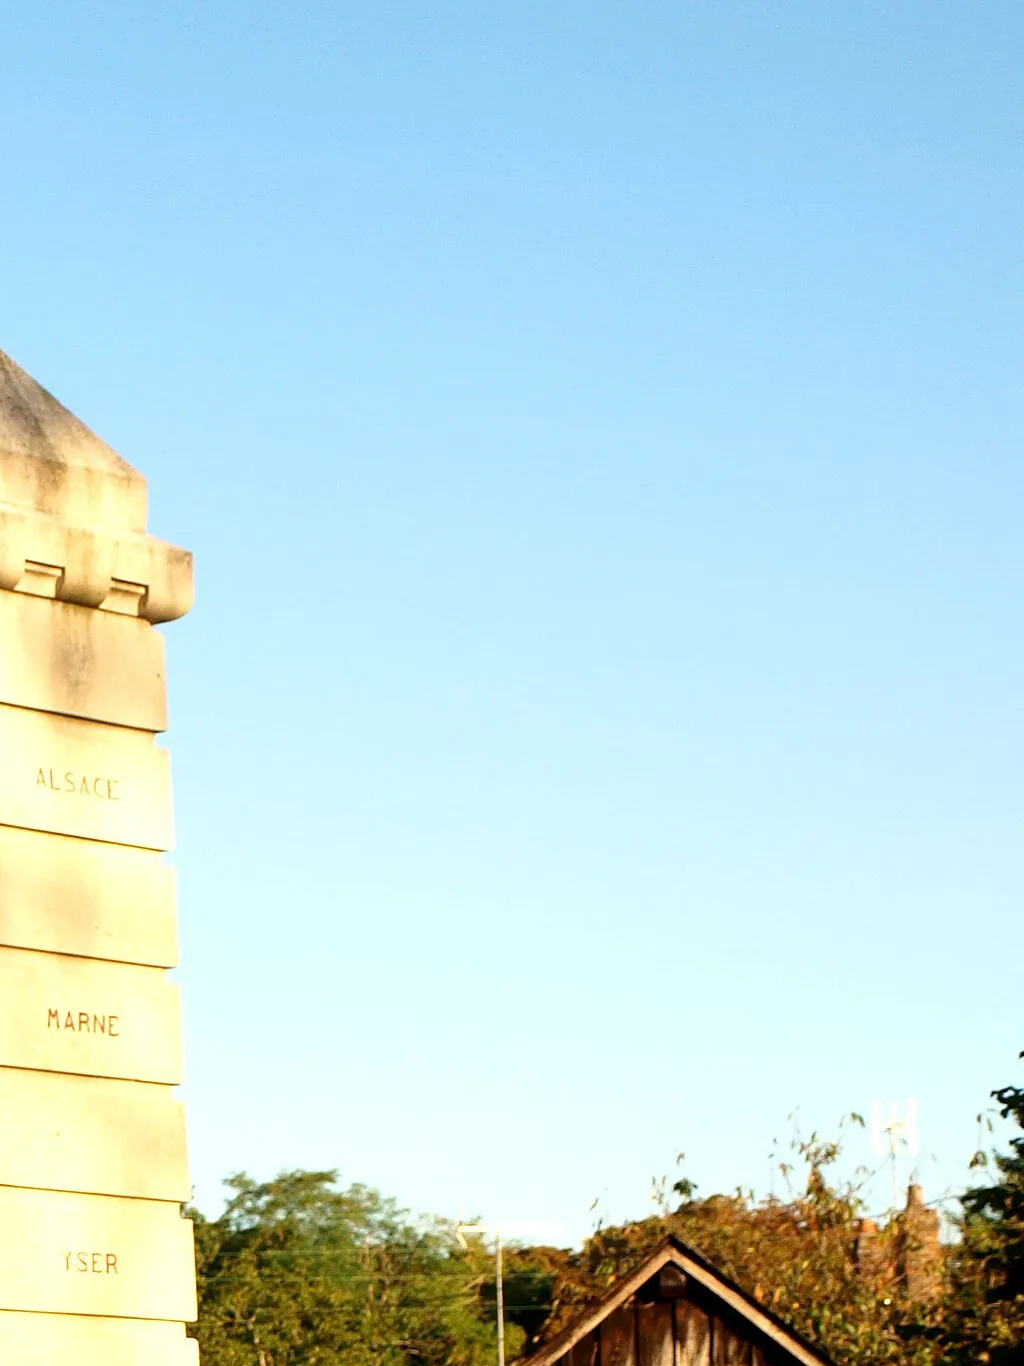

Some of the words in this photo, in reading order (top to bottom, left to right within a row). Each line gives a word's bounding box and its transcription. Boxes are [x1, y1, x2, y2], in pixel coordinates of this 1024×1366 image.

[36, 767, 120, 800] ALSACE
[47, 1008, 119, 1037] MARNE
[65, 1251, 118, 1274] YSER
